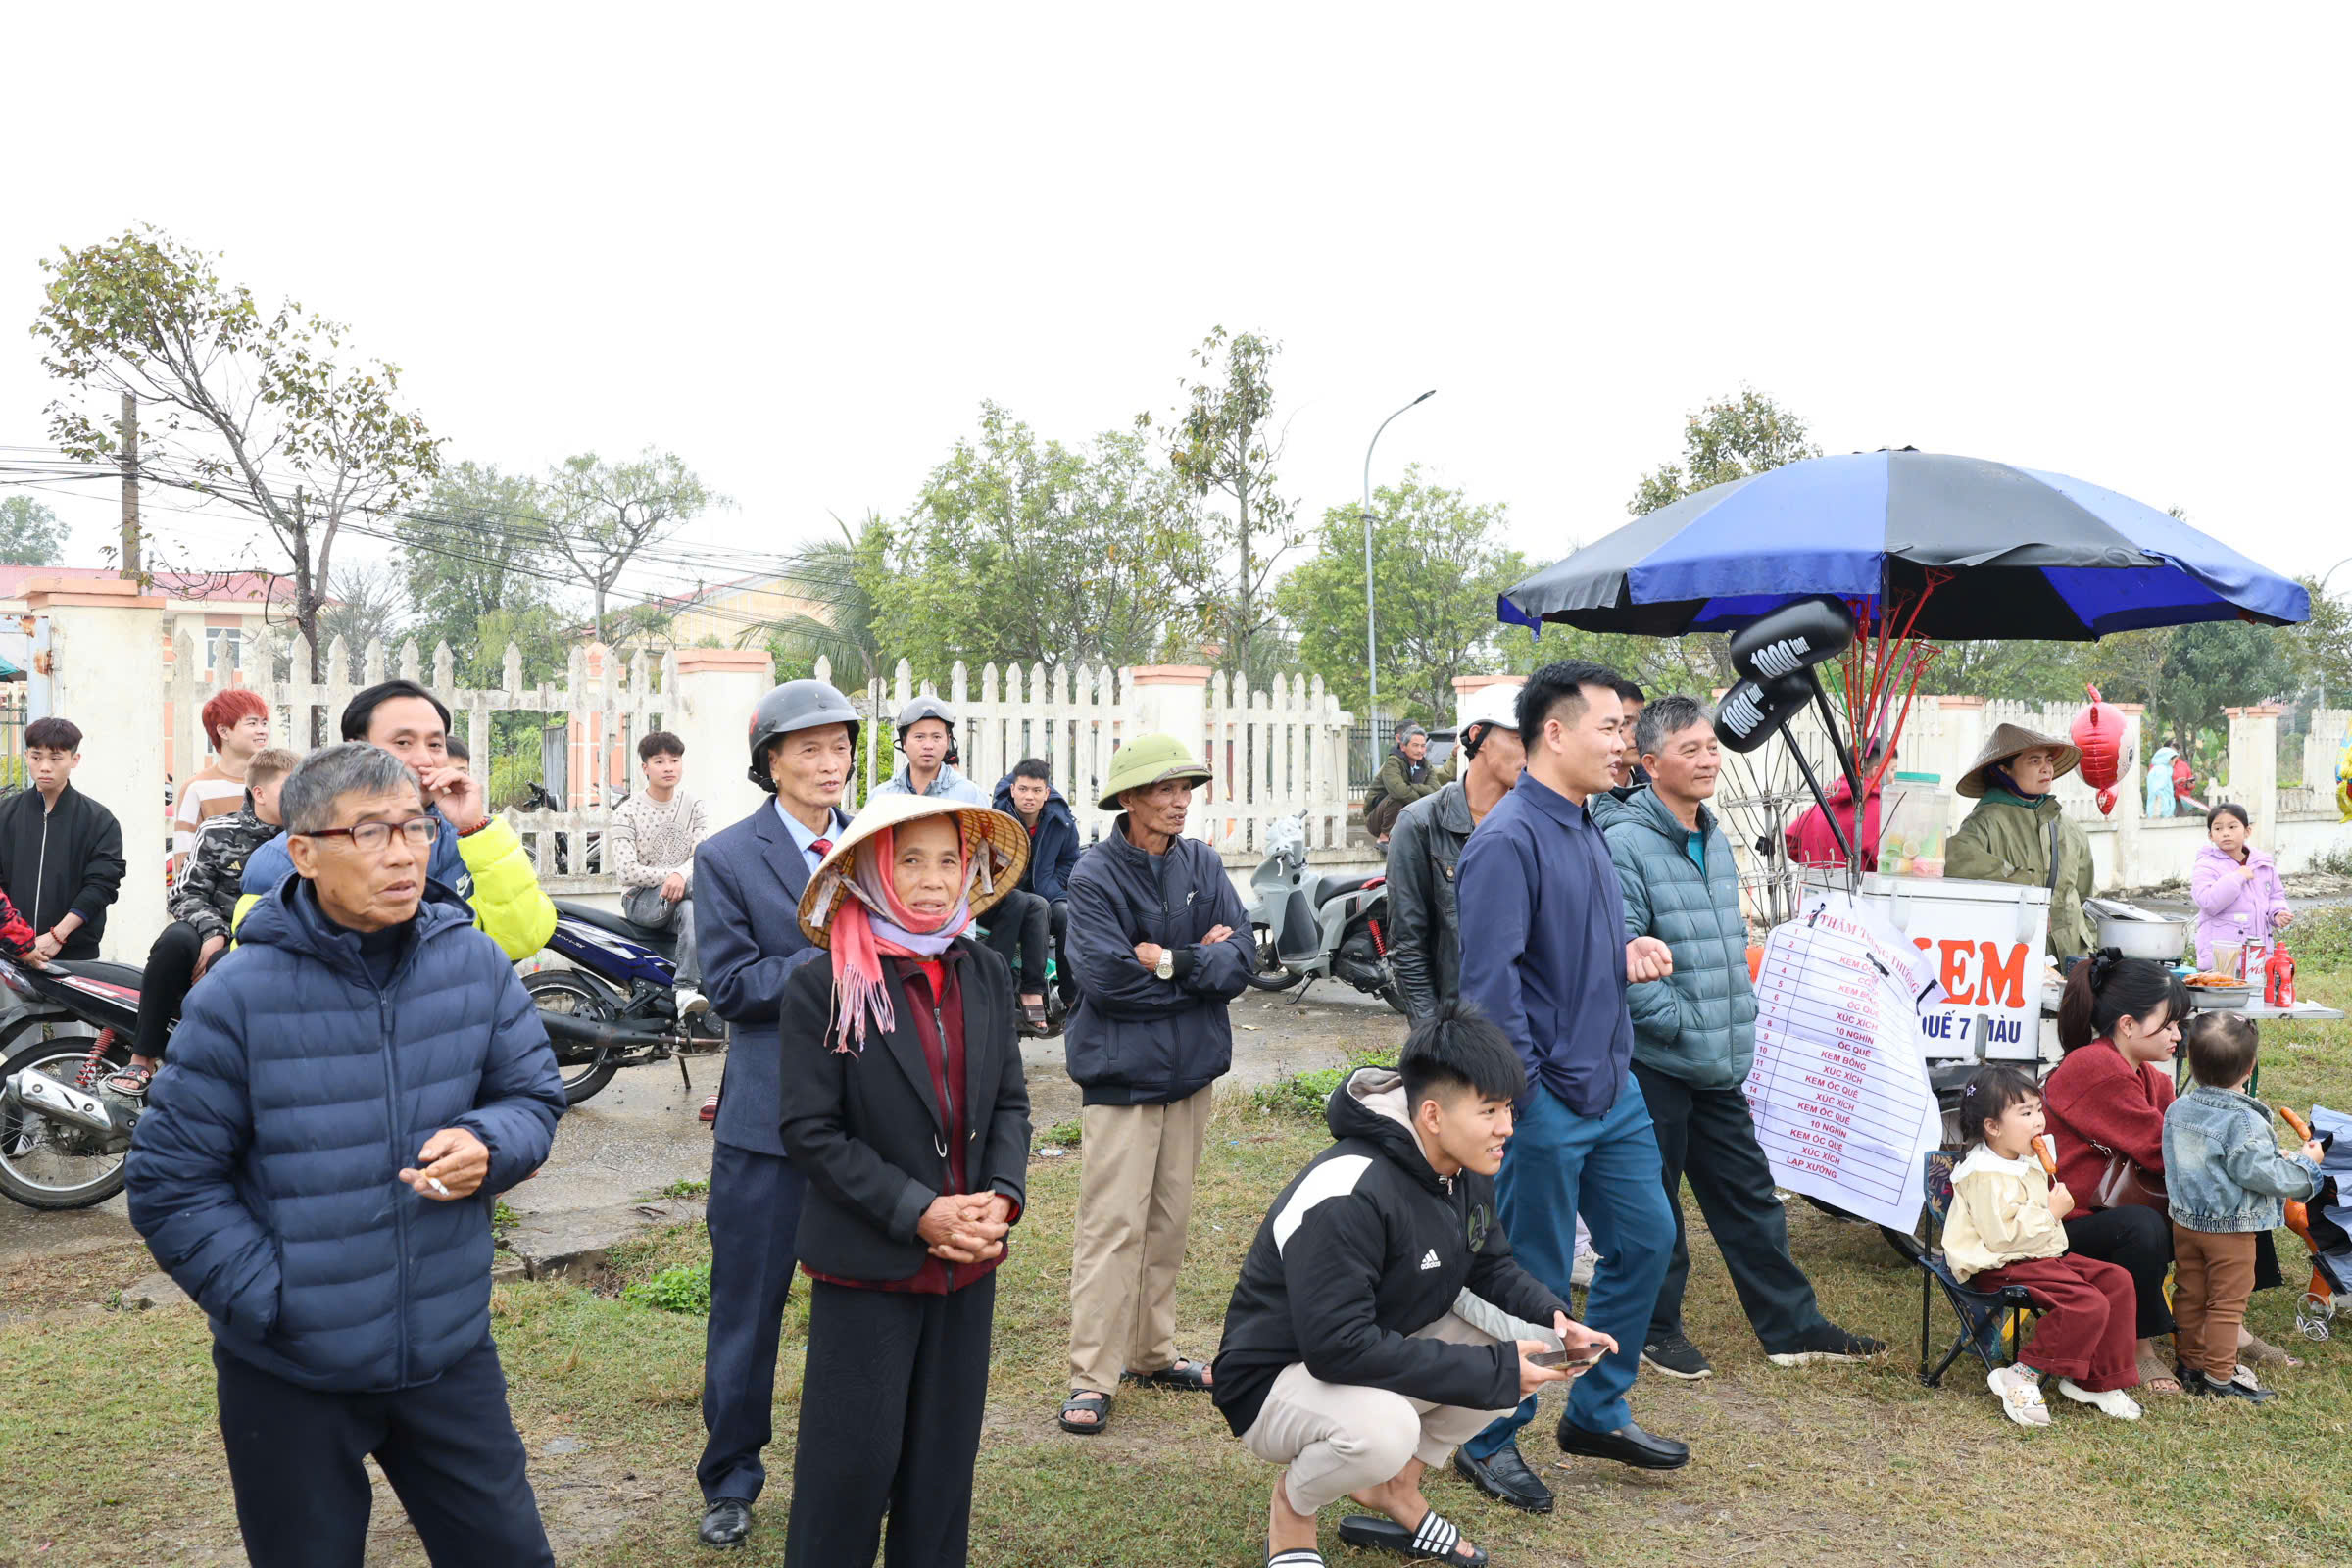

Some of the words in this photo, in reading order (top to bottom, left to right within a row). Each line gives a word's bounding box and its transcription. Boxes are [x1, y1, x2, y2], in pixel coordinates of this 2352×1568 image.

[1750, 640, 1803, 679] 1000
[1722, 692, 1765, 739] 1000
[1839, 956, 1860, 968] KEM
[1913, 937, 2030, 1008] EM
[1838, 985, 1859, 997] KEM
[1837, 1012, 1855, 1024] XÚC
[1836, 1027, 1845, 1036] 10
[1959, 1018, 1971, 1040] 7
[1821, 1050, 1841, 1062] KEM
[1823, 1065, 1842, 1078] XÚC
[1804, 1075, 1826, 1087] KEM
[1752, 1072, 1761, 1081] 12
[1815, 1093, 1836, 1104] XÚC
[1797, 1102, 1818, 1113] KEM
[1811, 1120, 1821, 1129] 10
[1790, 1129, 1811, 1141] KEM
[1801, 1147, 1821, 1158] XÚC
